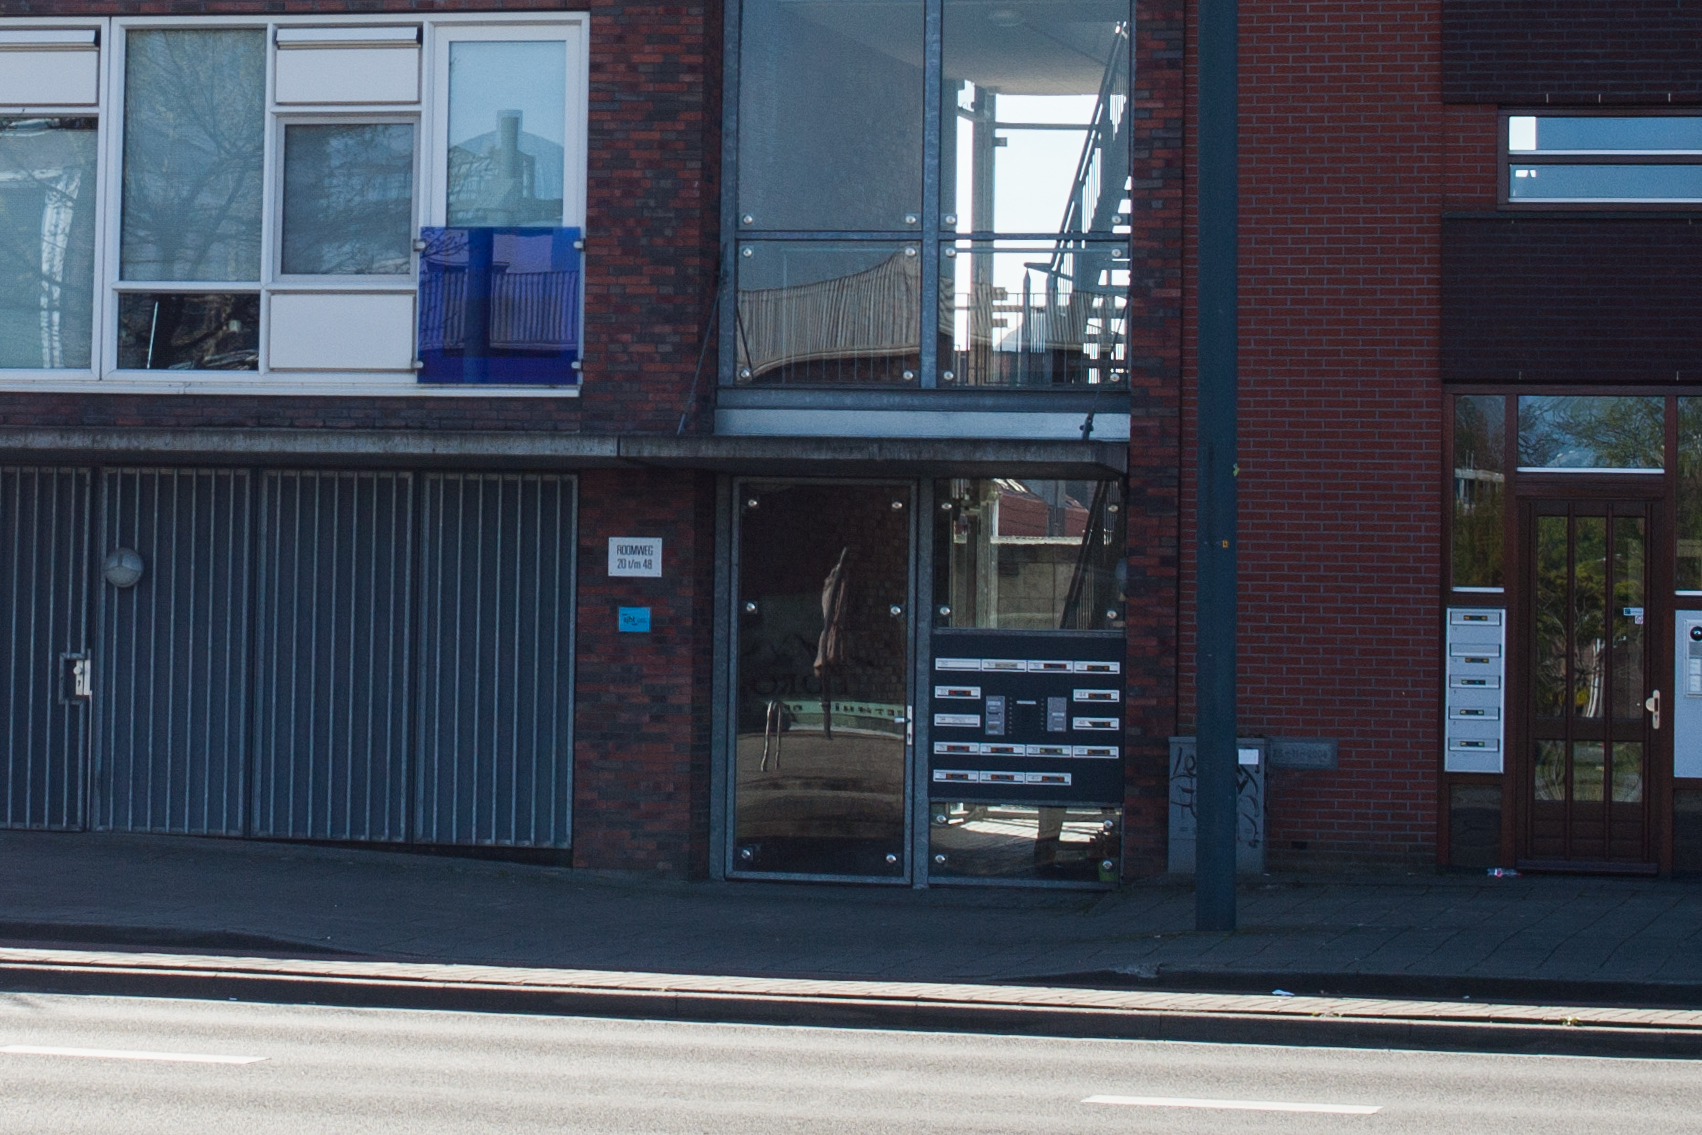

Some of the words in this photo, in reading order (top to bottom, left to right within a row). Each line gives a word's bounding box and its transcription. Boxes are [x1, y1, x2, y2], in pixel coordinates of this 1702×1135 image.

[616, 545, 653, 556] ROOMWEG
[617, 558, 627, 569] 20
[628, 559, 641, 569] t/m
[642, 558, 653, 570] 48
